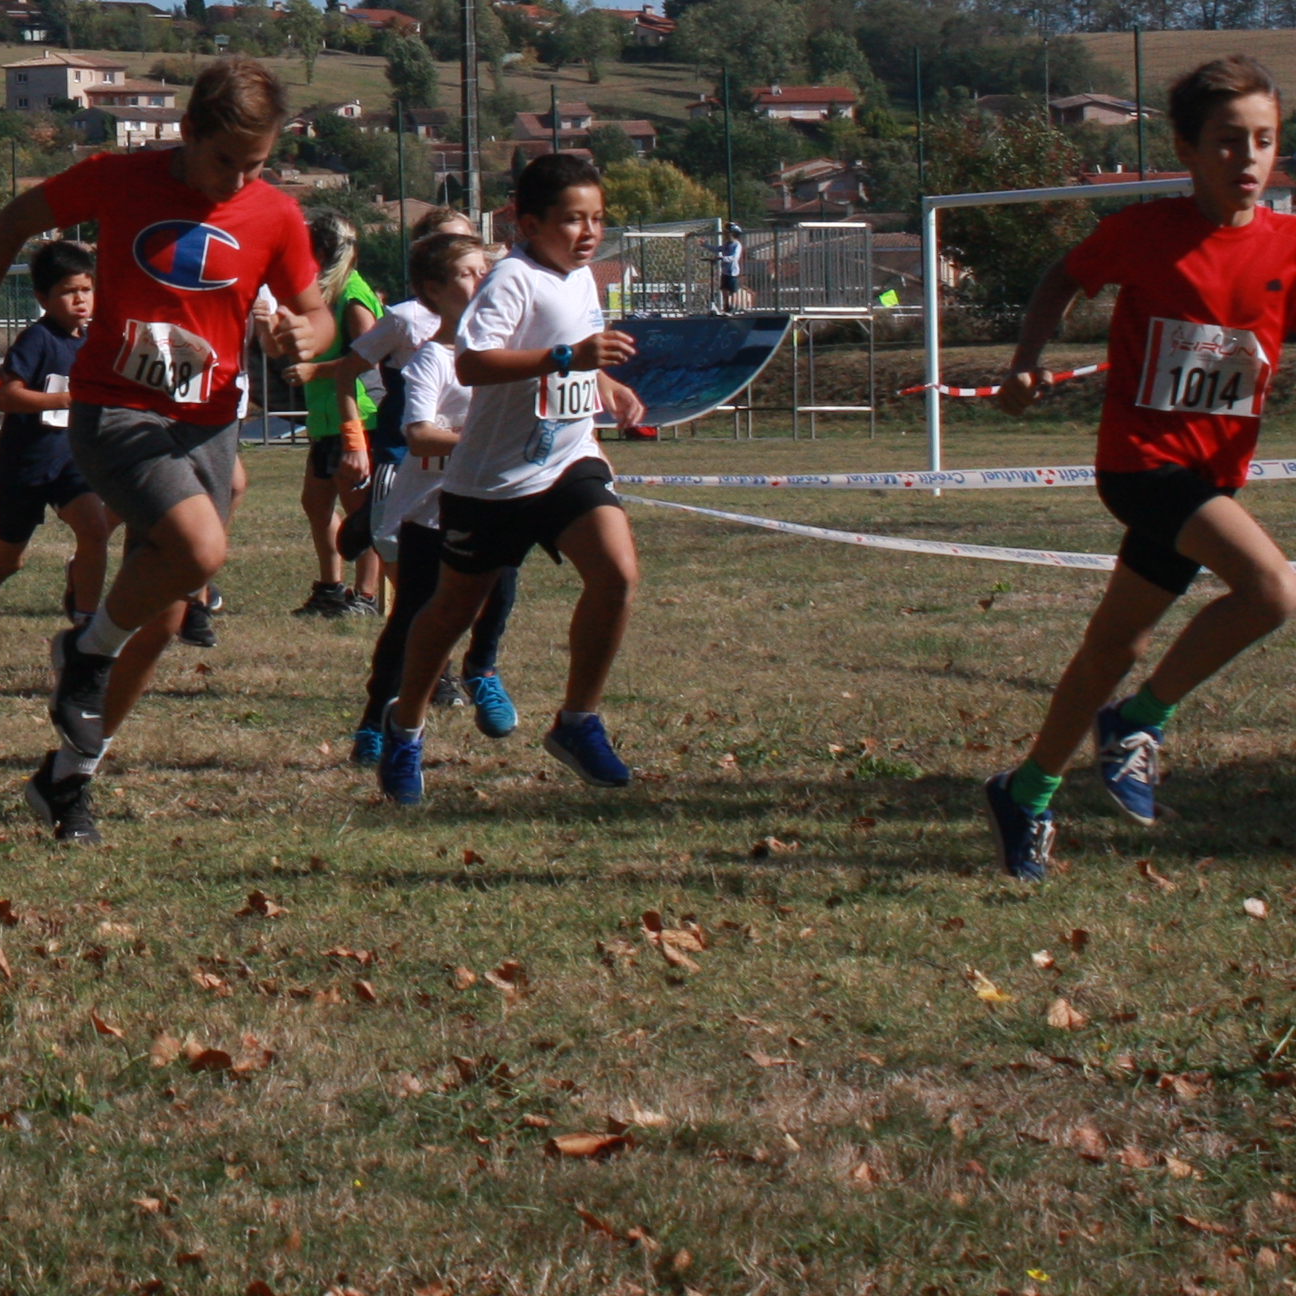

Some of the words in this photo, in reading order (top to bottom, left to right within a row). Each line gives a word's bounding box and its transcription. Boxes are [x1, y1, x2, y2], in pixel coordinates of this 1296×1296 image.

[134, 354, 192, 397] 1038
[1170, 366, 1242, 410] 1014
[918, 470, 964, 485] Crédit
[980, 469, 1038, 484] Mutuel
[1058, 467, 1096, 484] rédit
